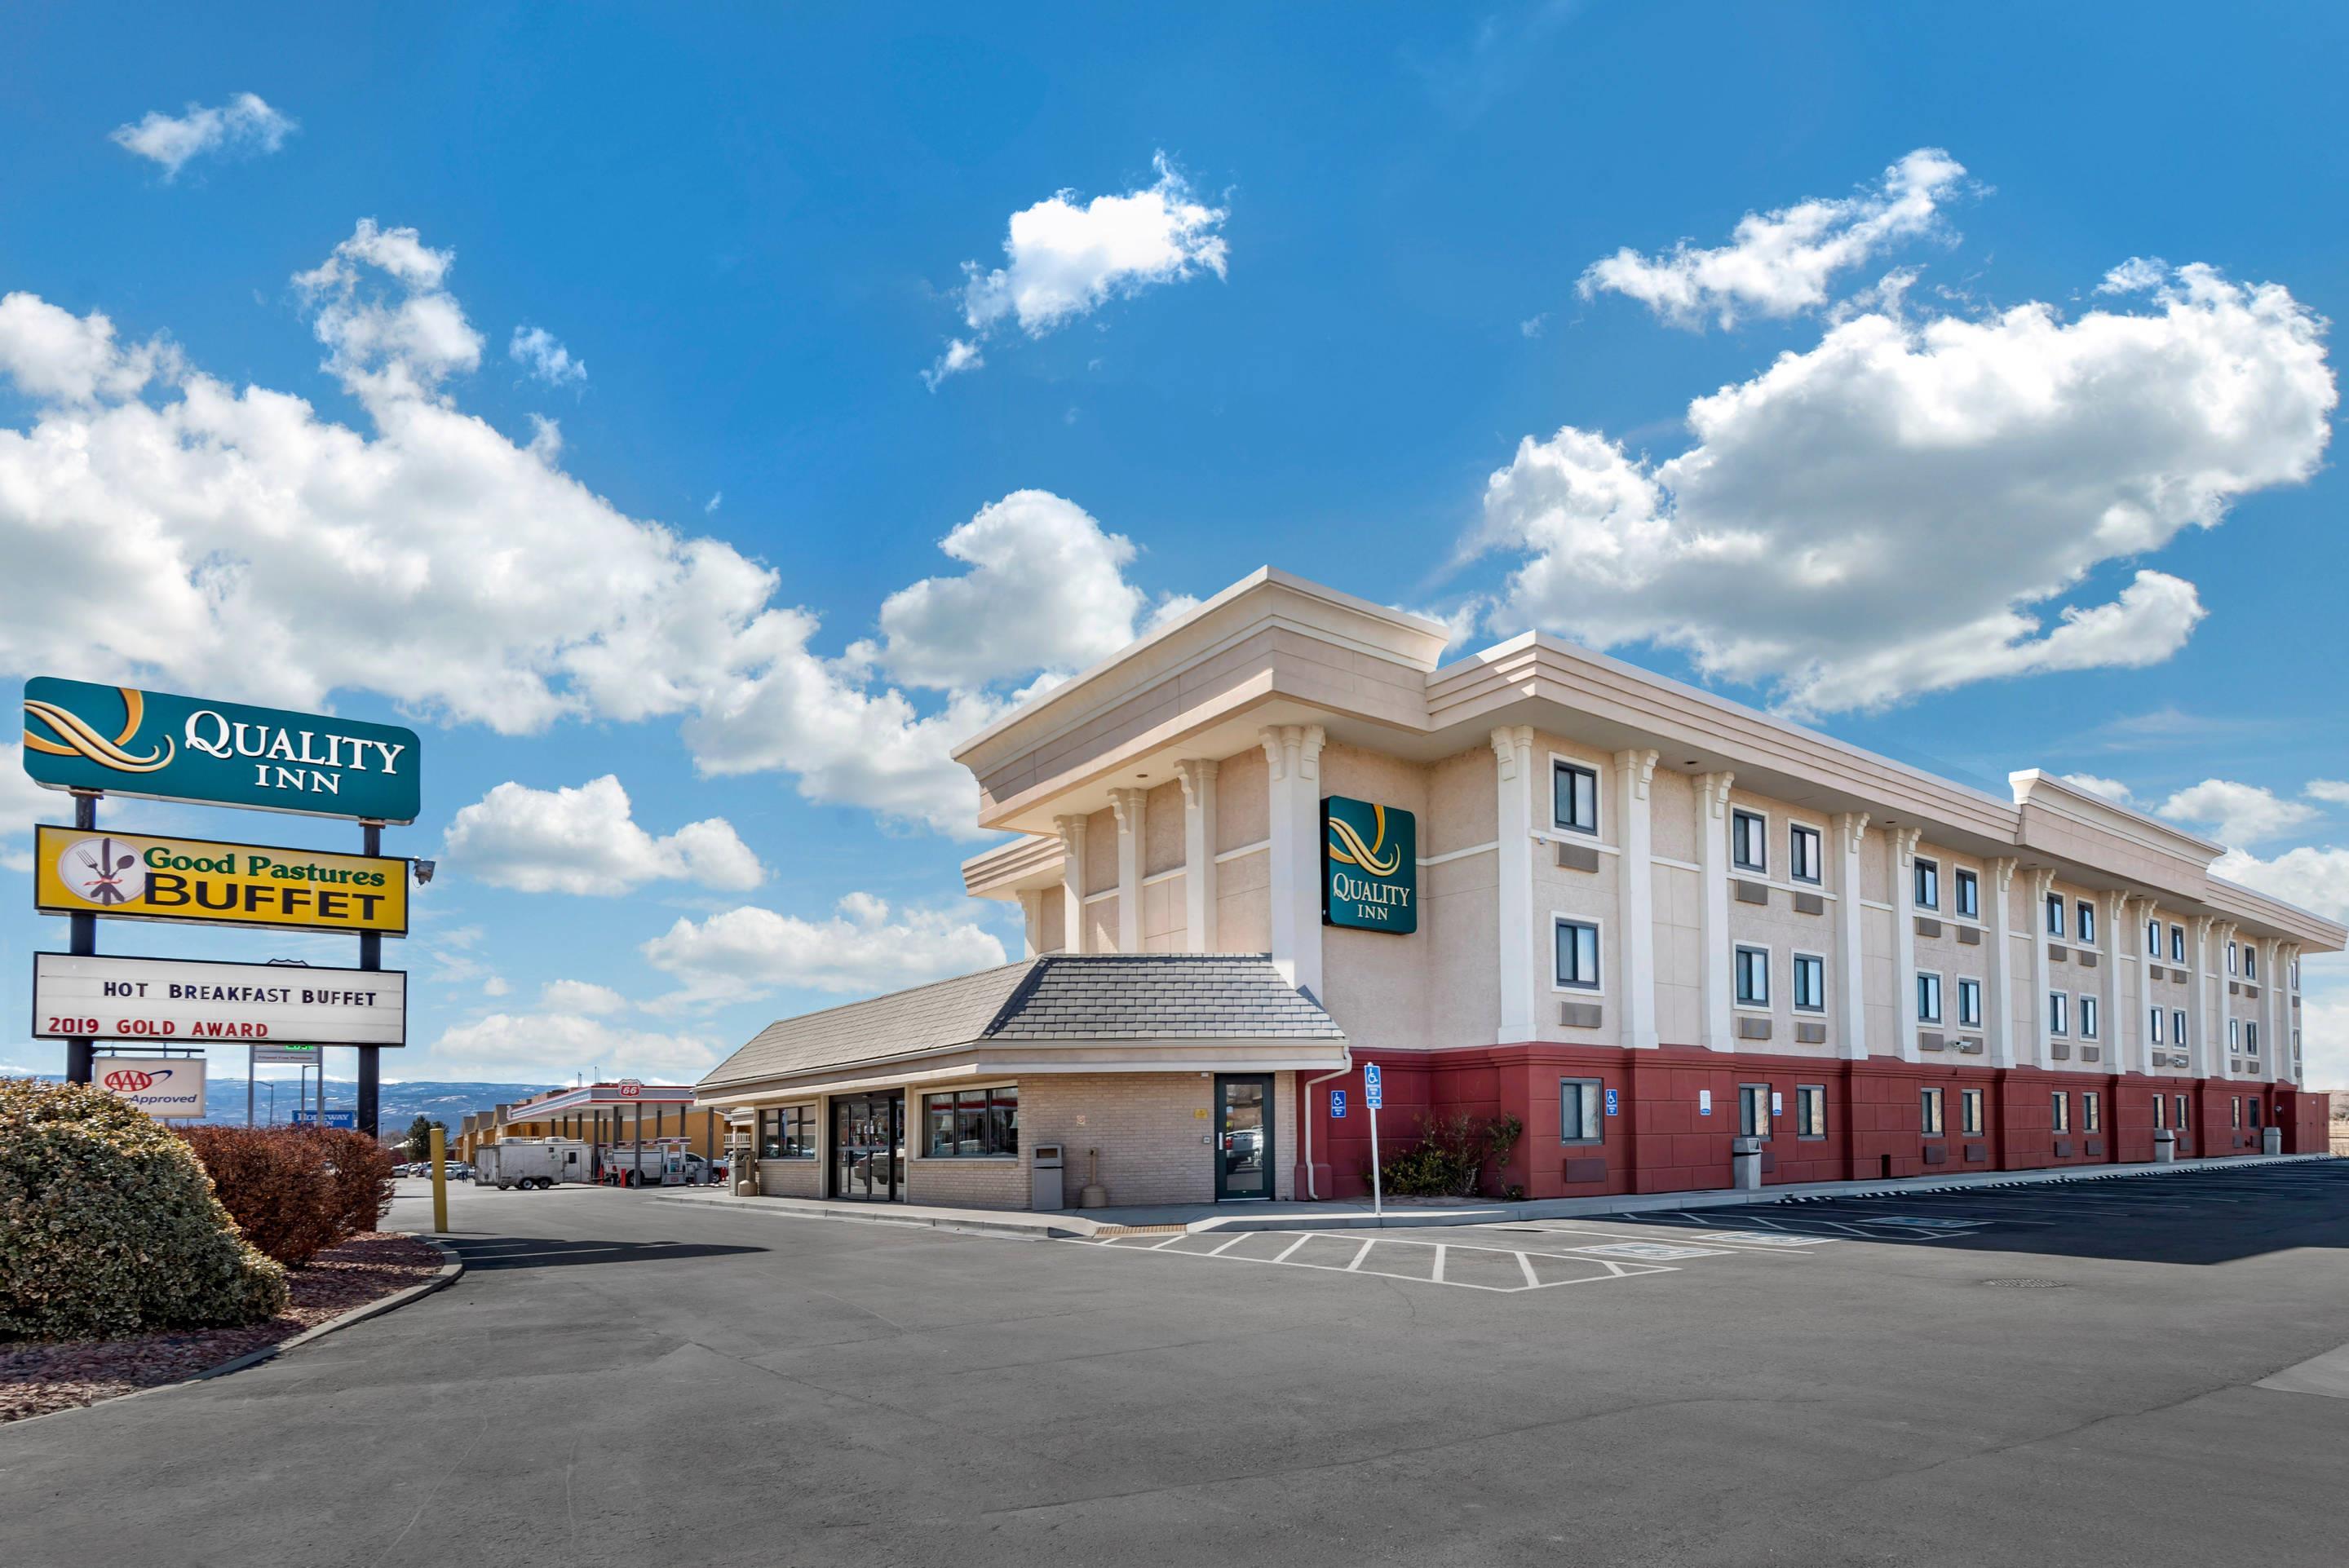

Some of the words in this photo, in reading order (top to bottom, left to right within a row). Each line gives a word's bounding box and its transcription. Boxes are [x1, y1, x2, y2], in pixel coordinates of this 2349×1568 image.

[184, 710, 405, 774] QUALITY
[255, 764, 341, 795] INN
[144, 846, 236, 874] Good
[248, 855, 385, 886] Pastures
[144, 872, 385, 920] BUFFET
[1333, 872, 1410, 907] QUALITY
[1358, 903, 1388, 921] INN
[104, 982, 148, 997] HOT
[169, 984, 290, 1003] BREAKFAST
[302, 989, 377, 1006] BUFFET
[48, 1017, 99, 1033] 2019
[117, 1019, 175, 1036] GOLD
[192, 1022, 268, 1038] AWARD
[108, 1071, 147, 1091] AAA
[623, 1086, 638, 1094] 66
[130, 1093, 197, 1105] Approved
